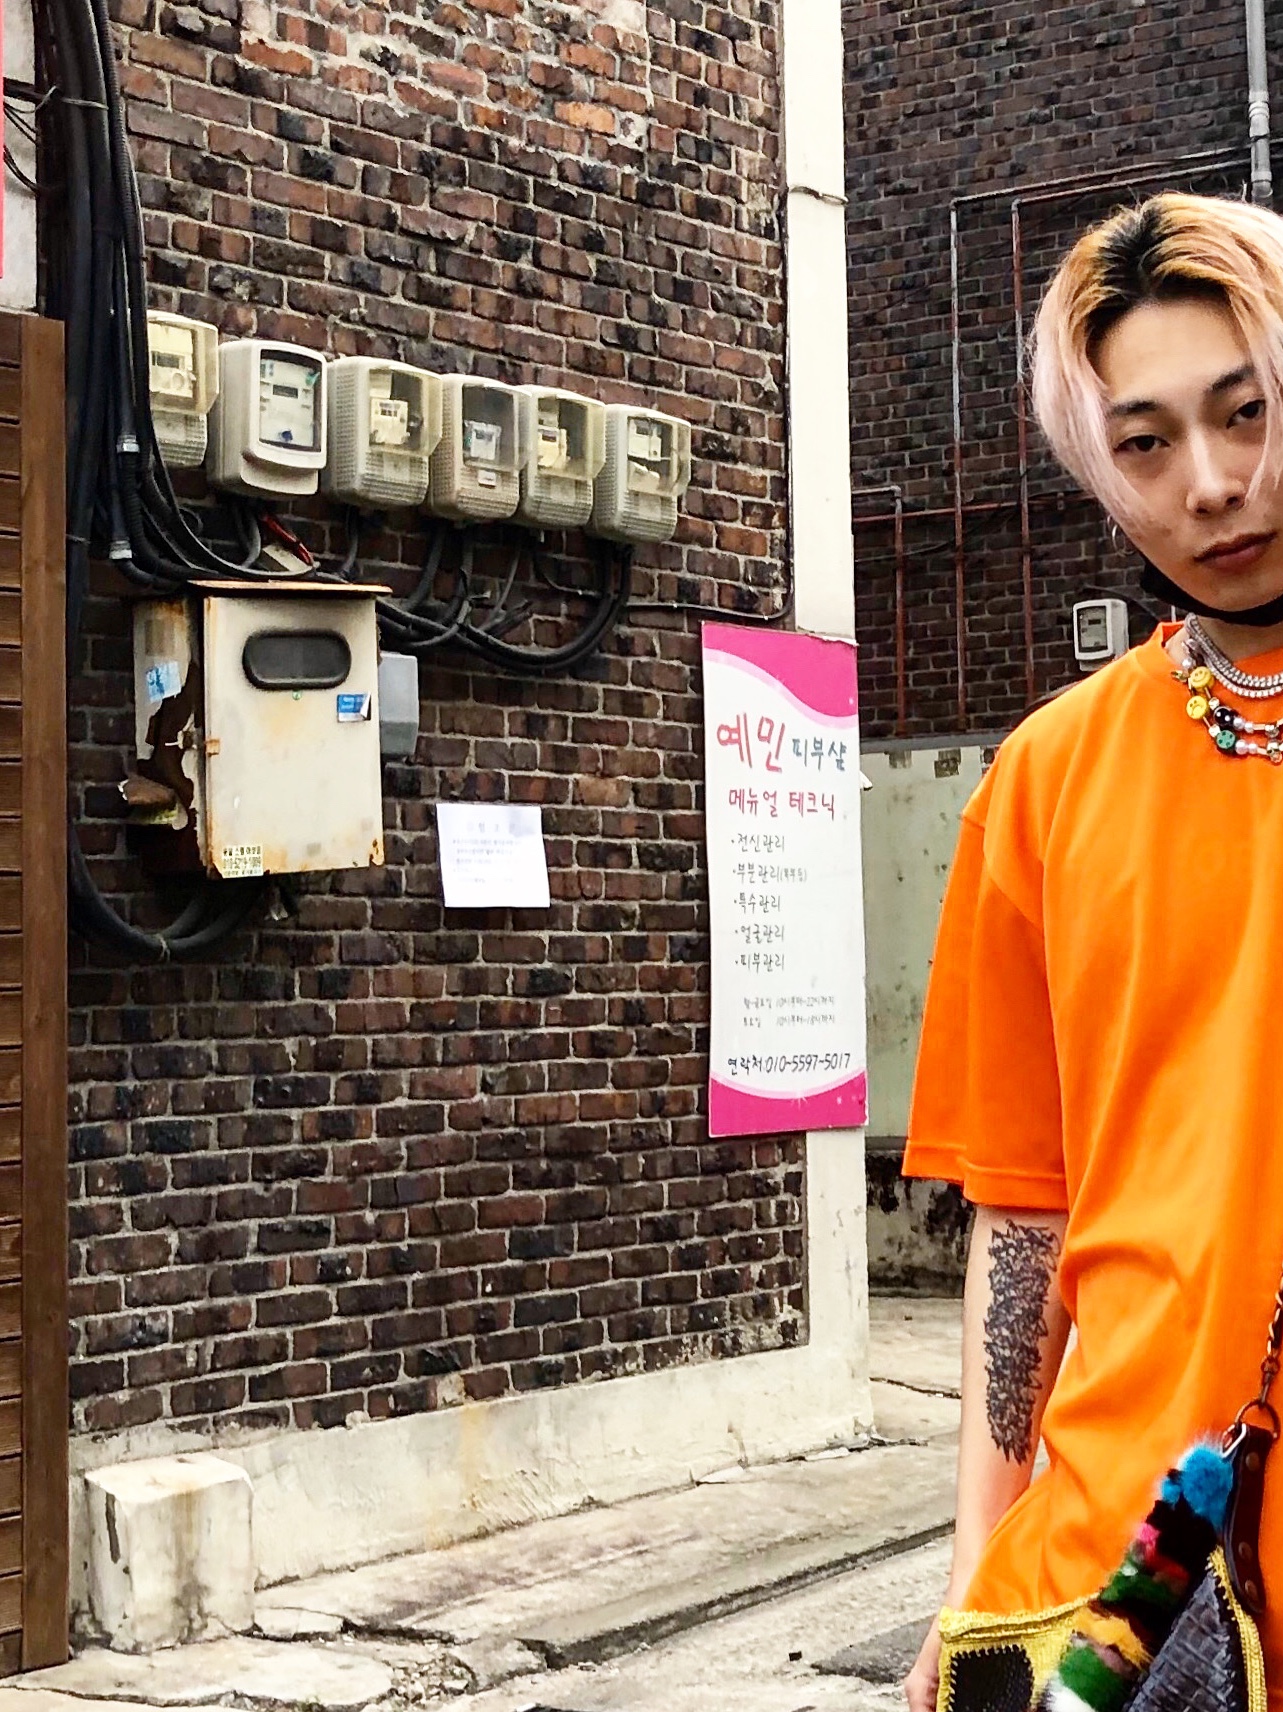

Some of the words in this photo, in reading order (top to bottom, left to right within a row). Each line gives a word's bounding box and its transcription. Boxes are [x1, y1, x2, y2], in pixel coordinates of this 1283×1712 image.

[716, 712, 786, 774] 예민
[728, 788, 779, 818] 메뉴얼
[788, 791, 836, 822] 테크닉
[737, 832, 785, 853] 전신관리
[738, 892, 781, 914] 특수관리
[740, 923, 785, 944] 얼굴관리
[740, 952, 785, 975] 피부관리
